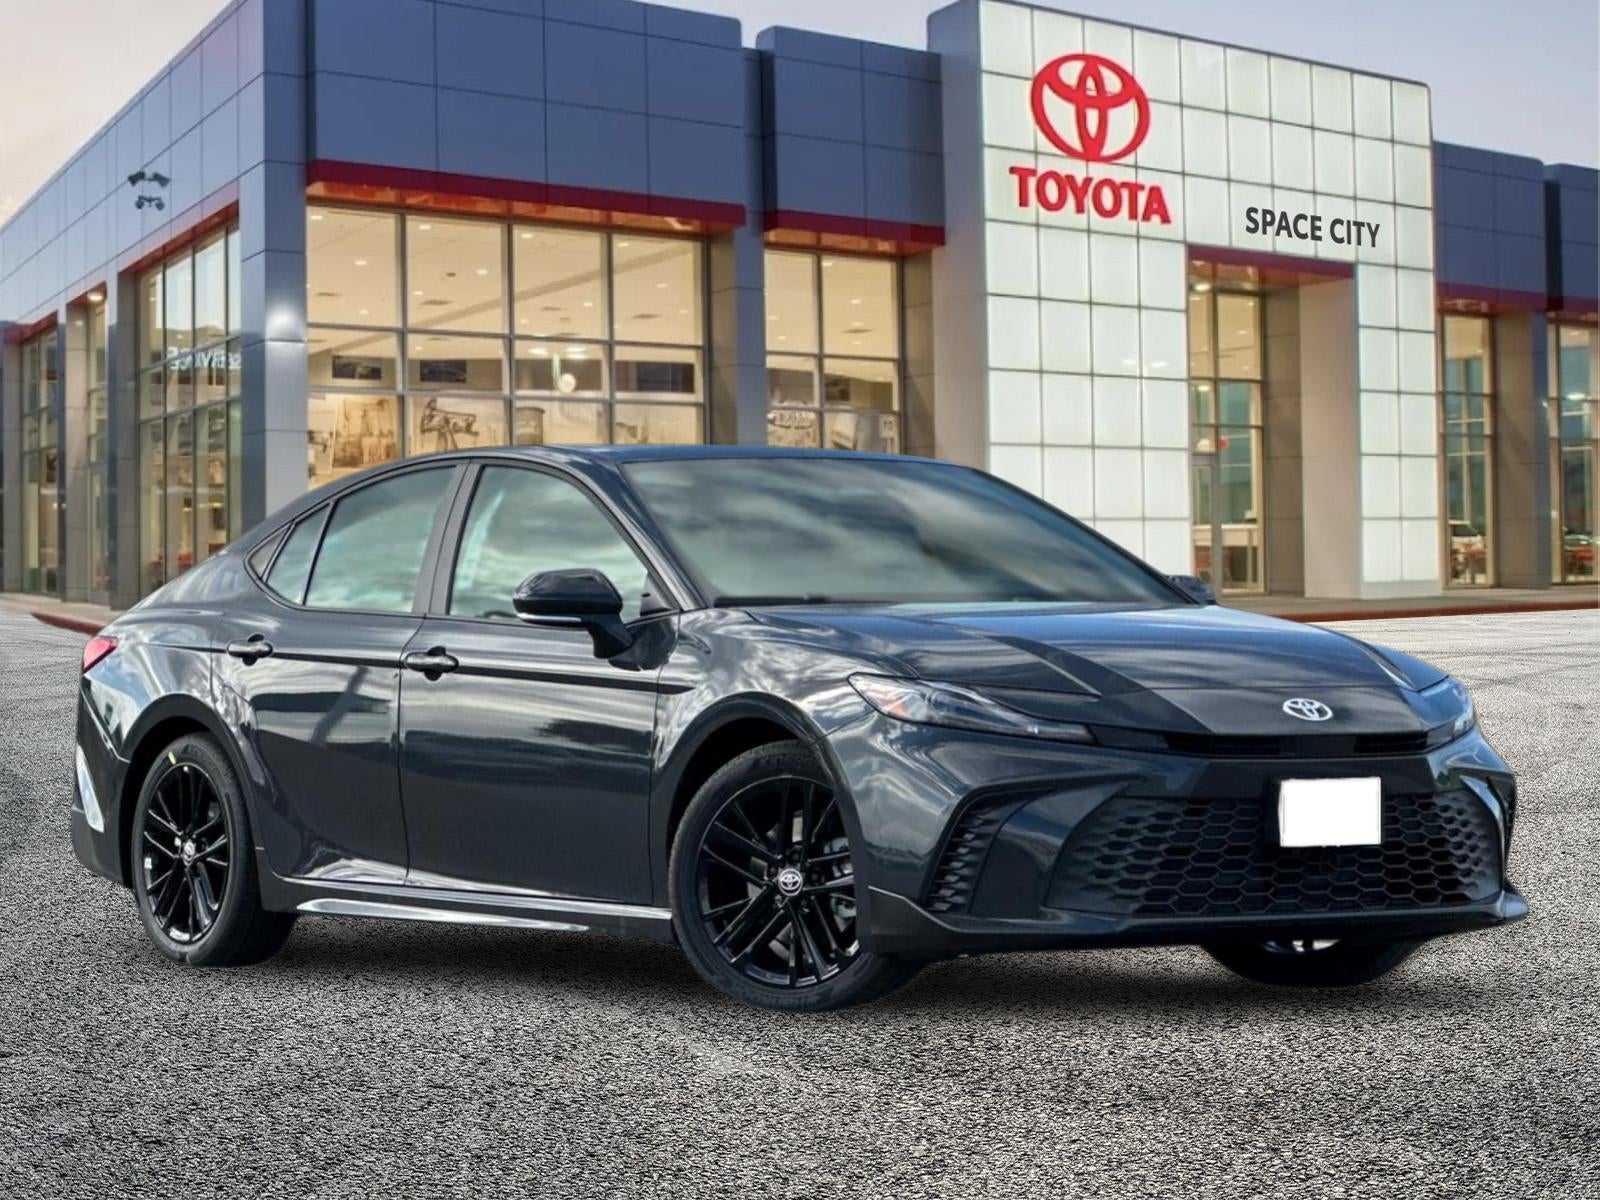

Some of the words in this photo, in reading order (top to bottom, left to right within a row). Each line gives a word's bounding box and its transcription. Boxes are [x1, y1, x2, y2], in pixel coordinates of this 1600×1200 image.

[1010, 166, 1171, 224] TOYOTA
[1245, 206, 1322, 242] SPACE
[1329, 218, 1380, 248] CITY
